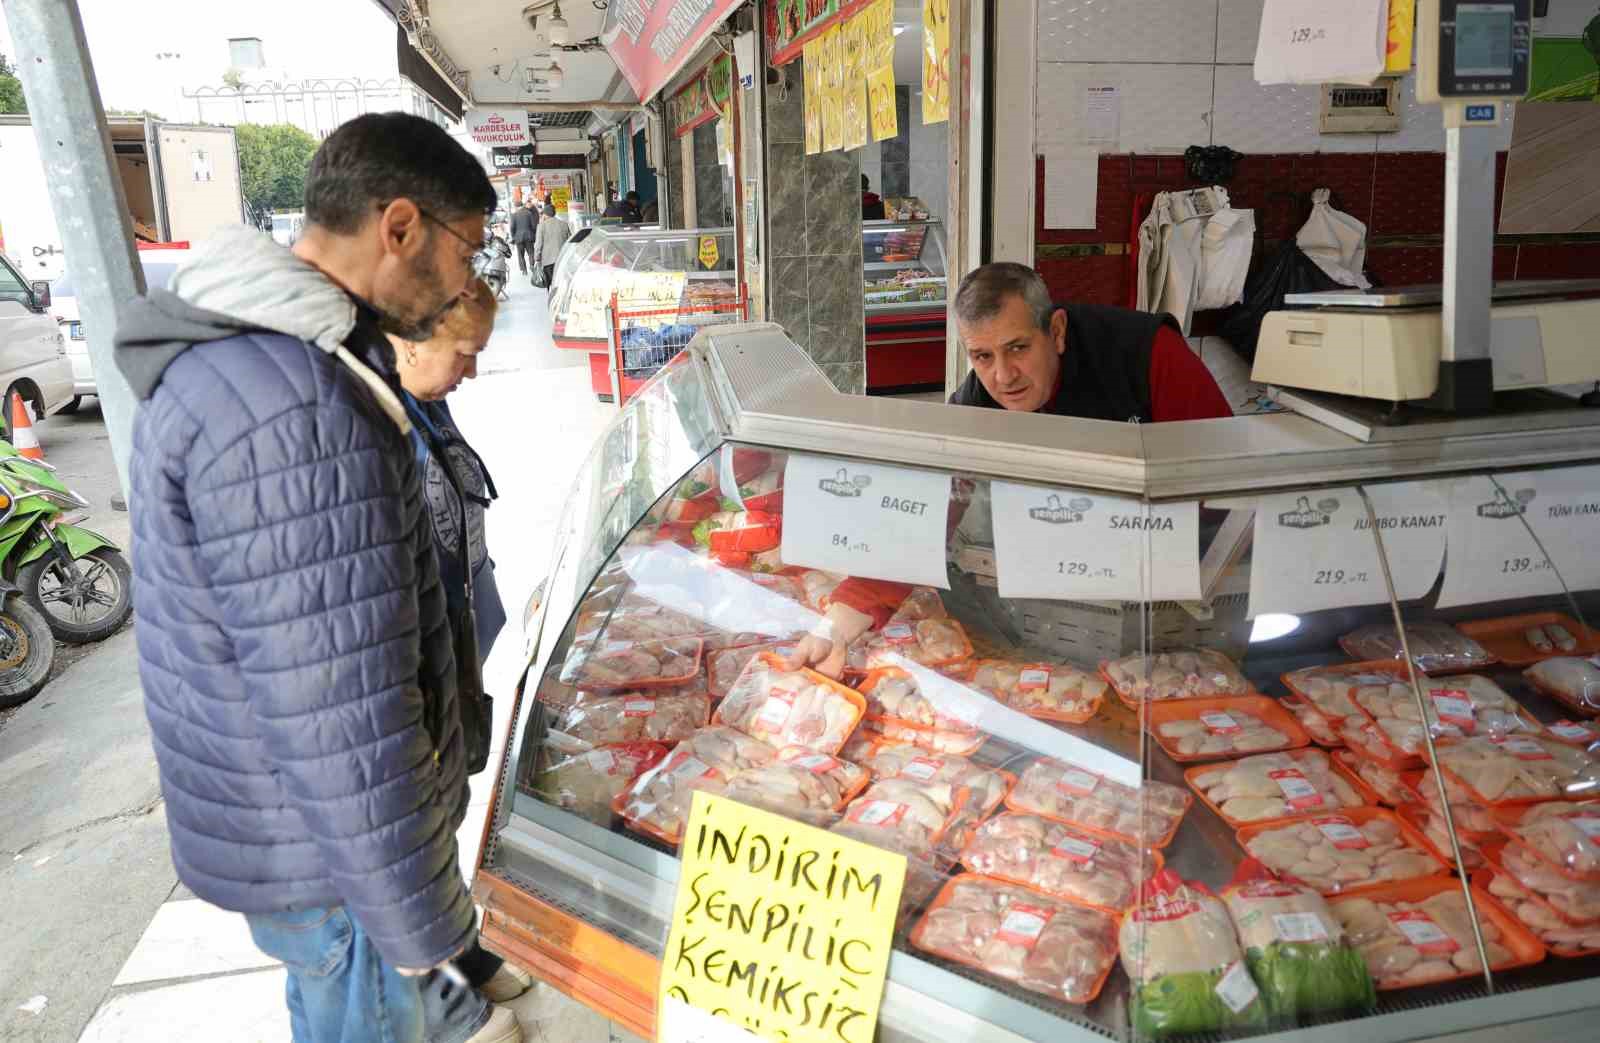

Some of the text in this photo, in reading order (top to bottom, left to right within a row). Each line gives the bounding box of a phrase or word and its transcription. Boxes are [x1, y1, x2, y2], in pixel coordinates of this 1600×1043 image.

[473, 123, 521, 133] KARDEŞLER
[472, 133, 526, 143] TAVUKÇULUK
[523, 155, 533, 166] ET
[880, 495, 928, 515] BAGET
[1548, 502, 1600, 517] TÜM KAN
[1109, 515, 1174, 531] SARMA
[1400, 515, 1446, 528] KANAT
[695, 804, 882, 913] İNDİRİM
[686, 872, 873, 989] ŞENPİLİÇ
